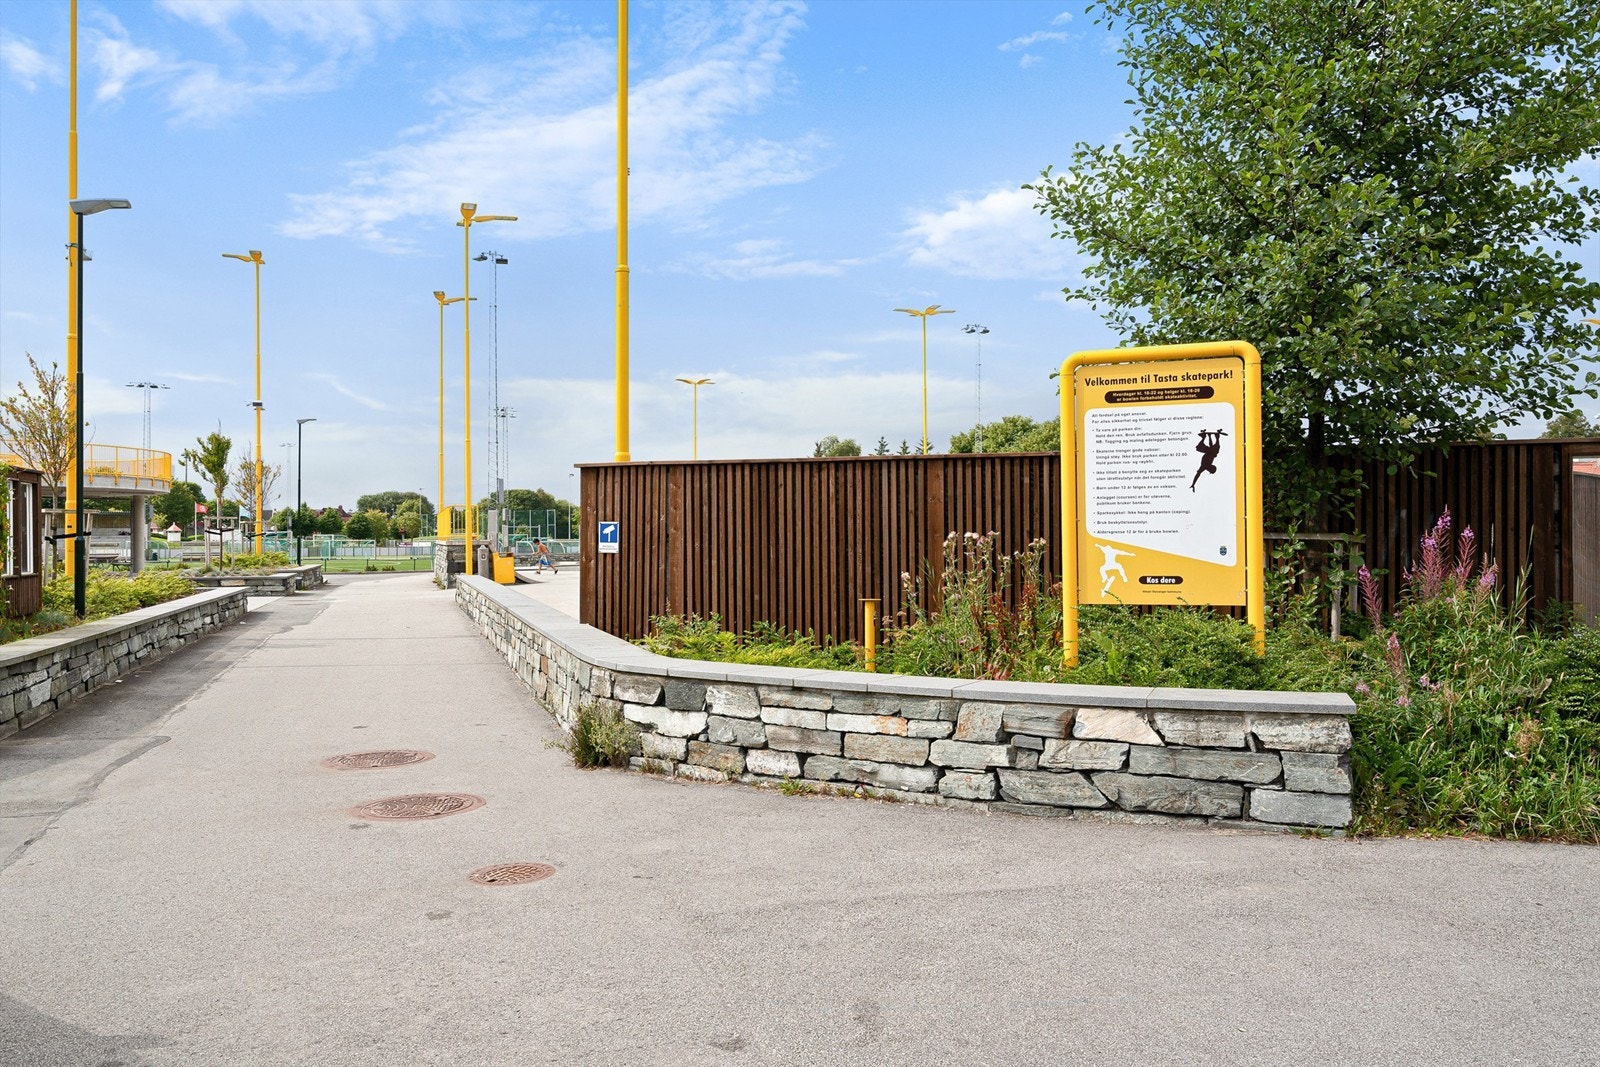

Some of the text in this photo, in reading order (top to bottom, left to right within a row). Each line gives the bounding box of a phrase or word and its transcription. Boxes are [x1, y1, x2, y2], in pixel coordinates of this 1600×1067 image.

[1085, 370, 1233, 386] Velkommen til Tasta skatepark!
